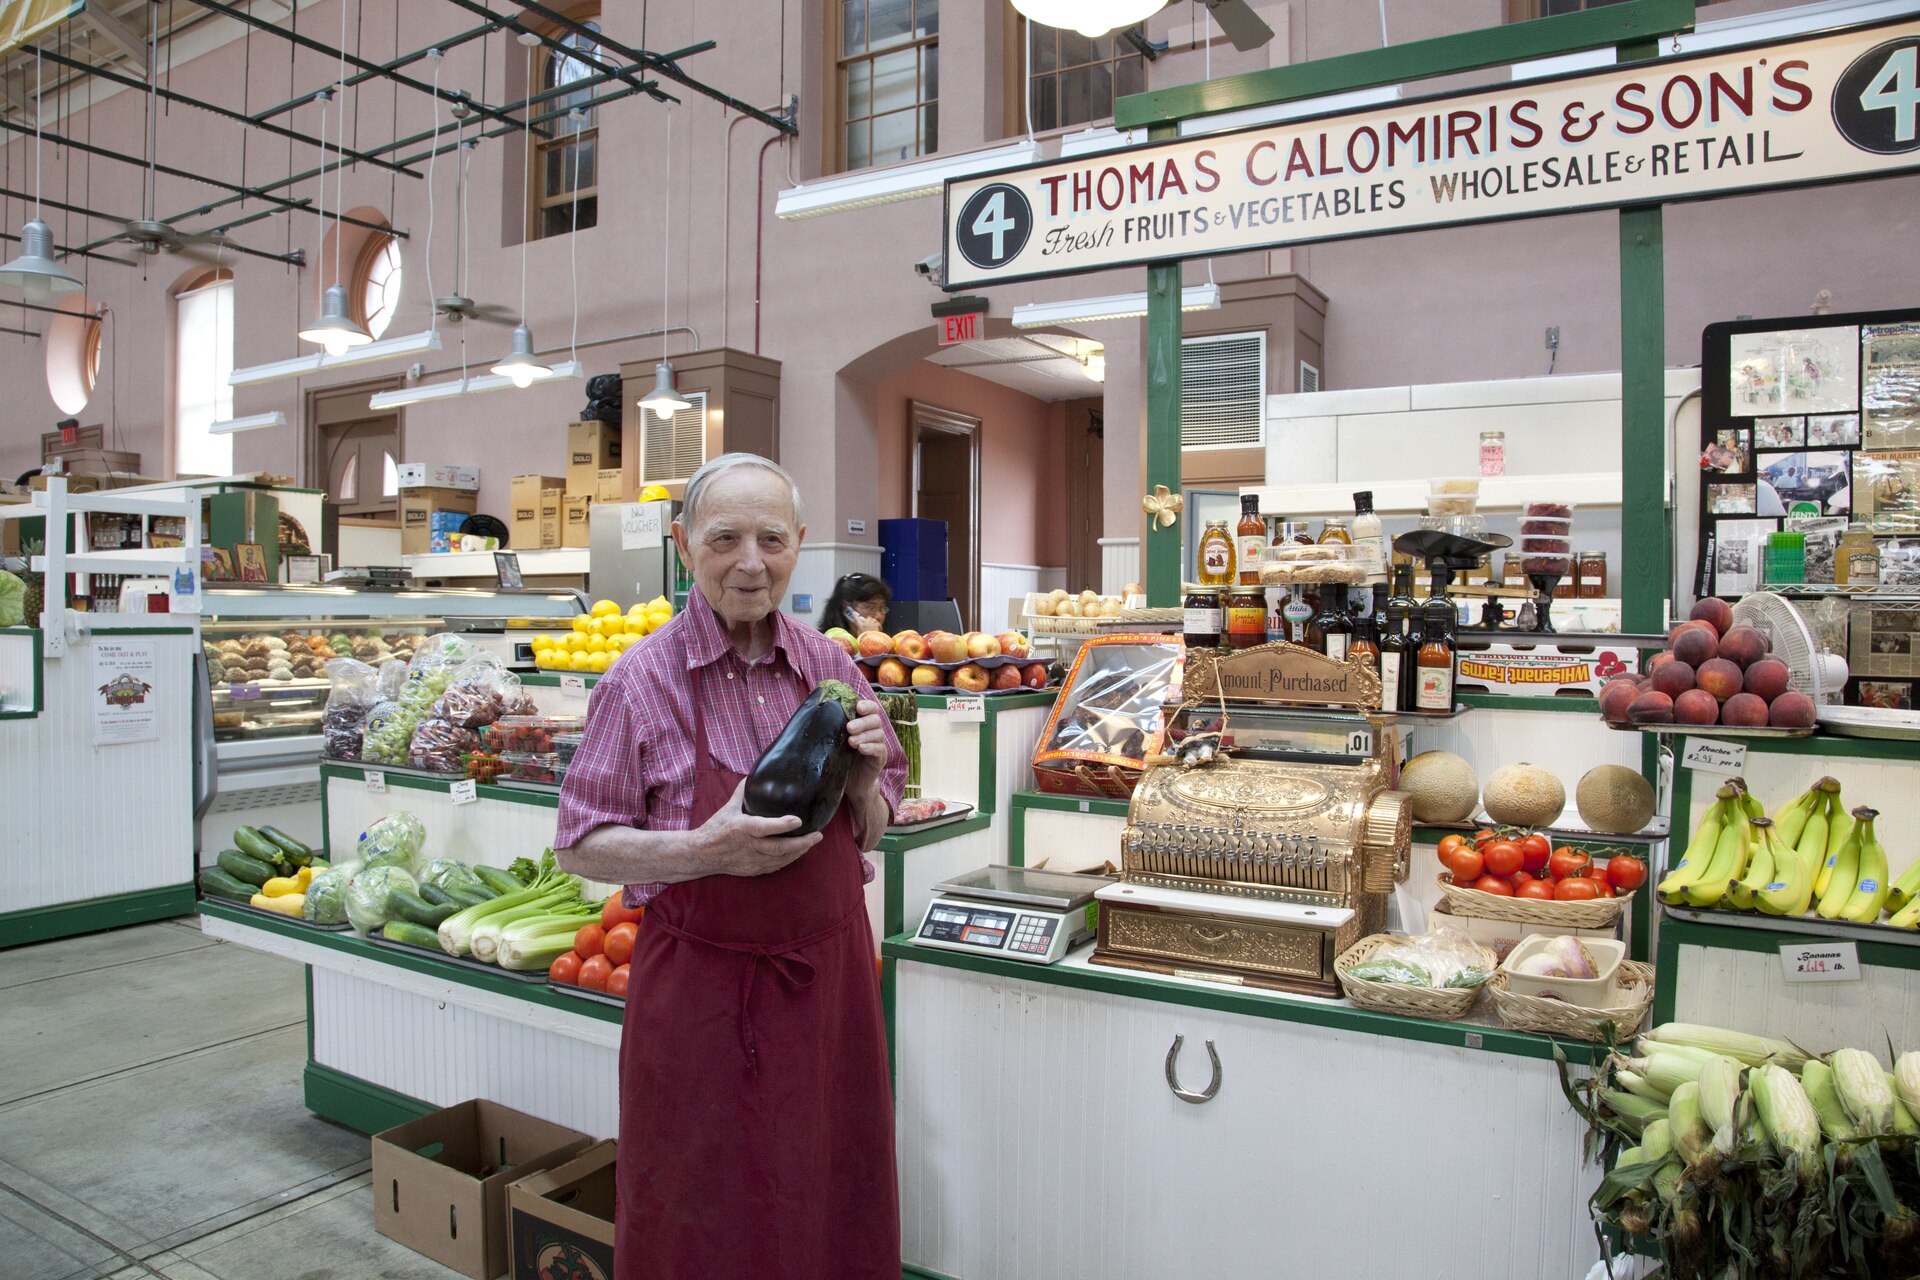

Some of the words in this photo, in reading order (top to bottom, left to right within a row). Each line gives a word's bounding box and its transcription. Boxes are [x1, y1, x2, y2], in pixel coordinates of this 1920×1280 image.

[1860, 46, 1920, 143] 4
[1040, 150, 1221, 216] THOMAS
[1246, 100, 1543, 186] CALOMIRIS
[1561, 101, 1604, 143] &
[1616, 58, 1813, 134] SON'S
[1042, 221, 1114, 257] Fresh
[1124, 206, 1209, 244] FRUITS
[1214, 210, 1226, 226] &
[1229, 179, 1405, 230] VEGETABLES
[1430, 151, 1622, 204] WHOLESALE
[1625, 154, 1646, 174] &
[1652, 130, 1805, 177] RETAIL
[972, 191, 1015, 260] 4
[945, 313, 976, 341] EXIT
[518, 511, 534, 519] SOLO
[623, 518, 669, 533] VOUCHER
[1206, 667, 1263, 691] Amount
[1264, 668, 1348, 693] Purchased
[1461, 661, 1506, 683] Farms
[1351, 734, 1369, 751] .01
[1698, 745, 1732, 756] Peaches
[1043, 751, 1086, 759] DELICIOUS
[1088, 755, 1140, 767] NATURALLY
[1797, 952, 1841, 961] Bananas
